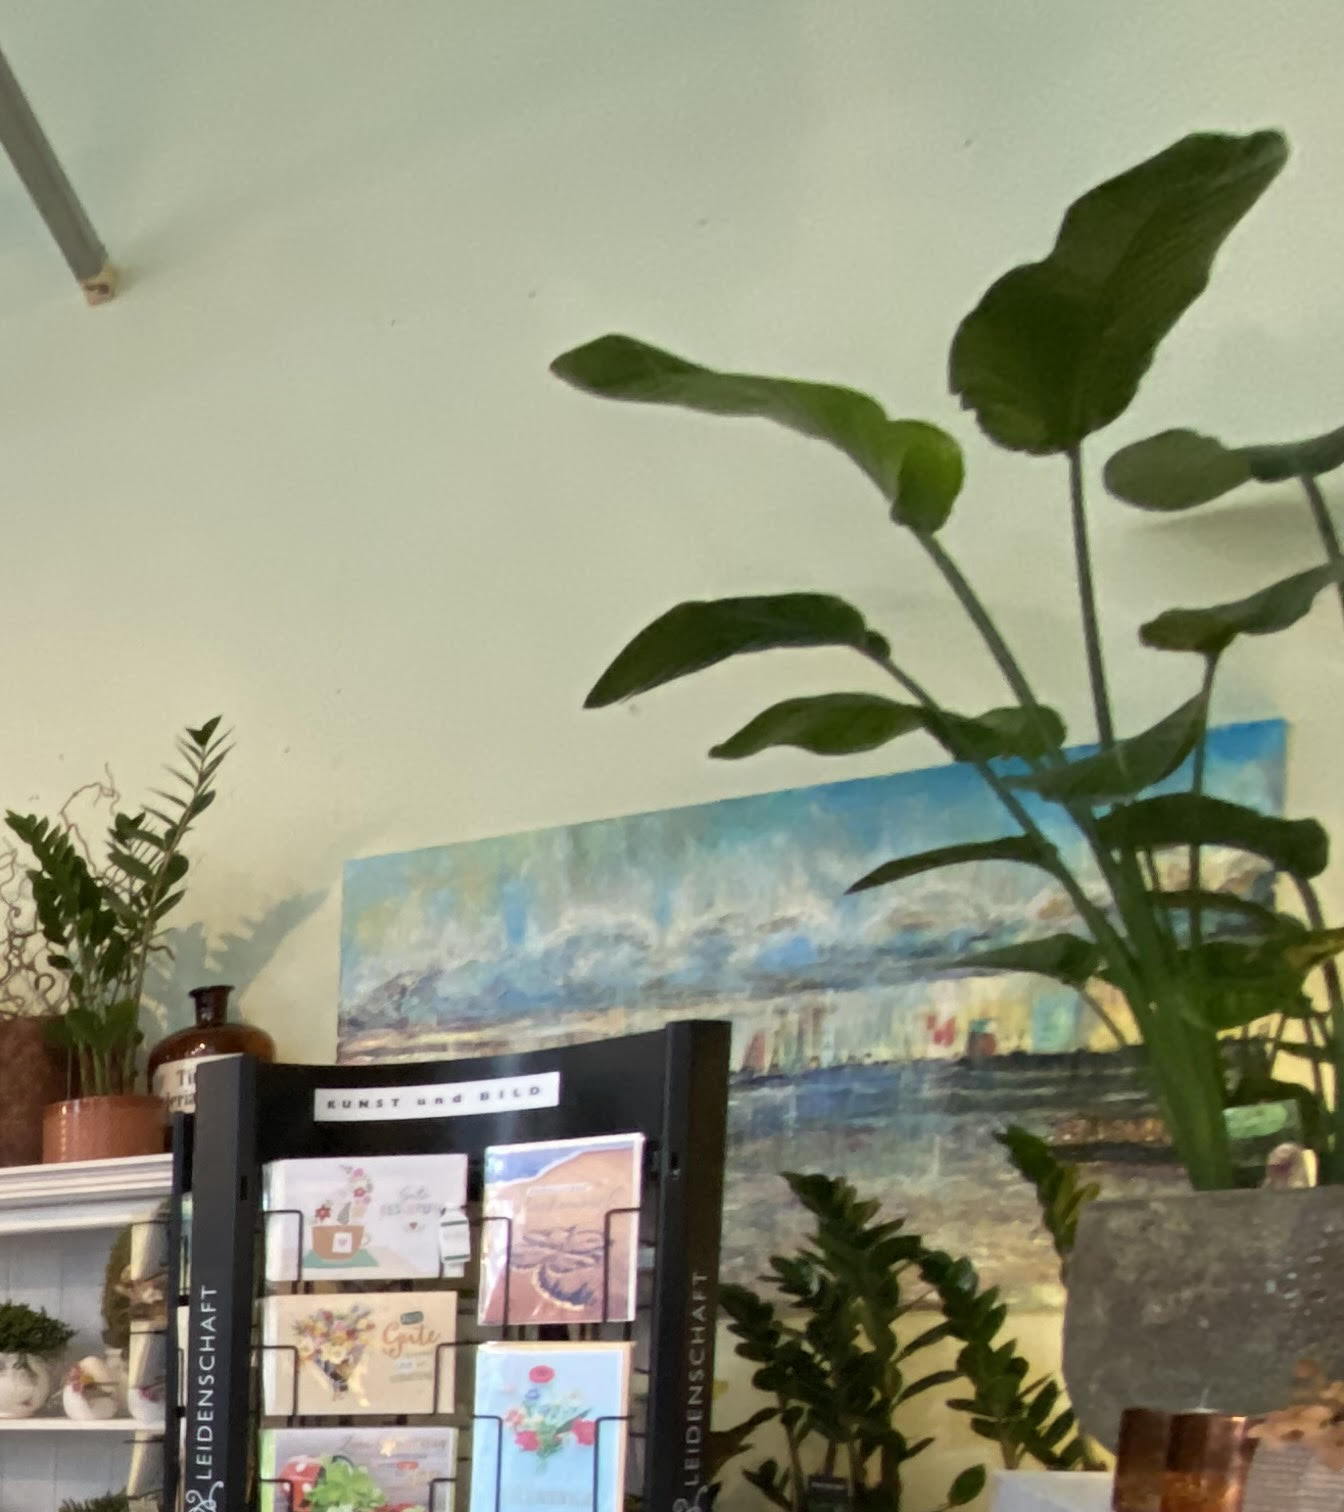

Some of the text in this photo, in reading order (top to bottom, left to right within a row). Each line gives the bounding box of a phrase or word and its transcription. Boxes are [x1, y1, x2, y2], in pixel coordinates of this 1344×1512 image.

[327, 1085, 541, 1110] KUNST und BILD
[195, 1285, 218, 1480] LEIDENSCHAFT
[381, 1321, 442, 1360] Gute
[684, 1271, 708, 1487] LEIDENSCHAFT
